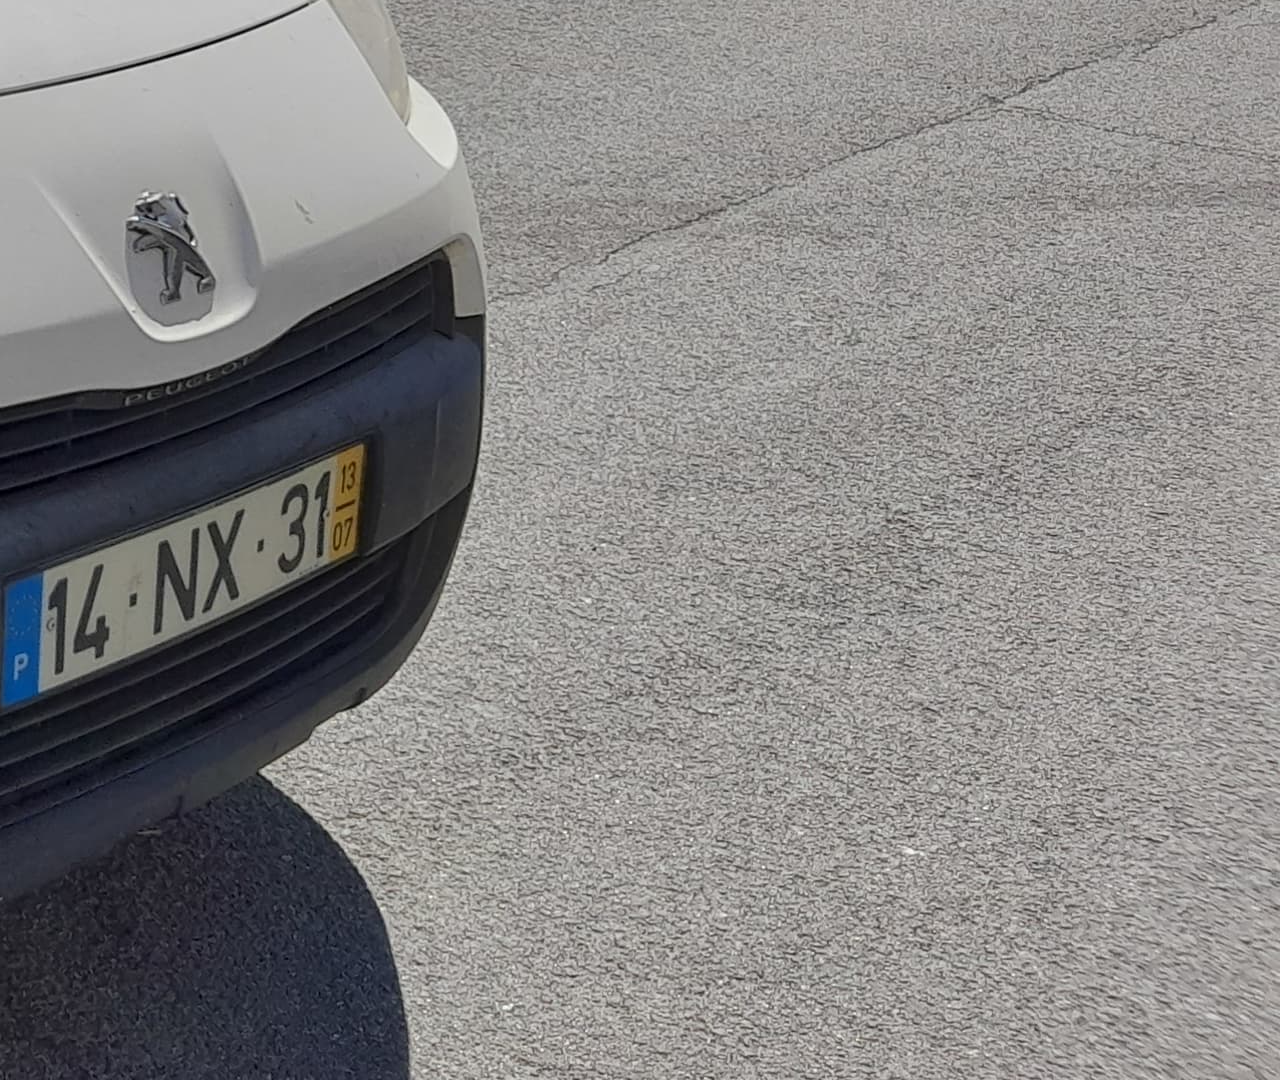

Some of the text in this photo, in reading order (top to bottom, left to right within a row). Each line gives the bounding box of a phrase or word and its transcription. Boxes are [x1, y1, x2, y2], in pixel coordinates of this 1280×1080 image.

[341, 460, 356, 493] 13
[331, 517, 353, 551] 07
[13, 653, 28, 681] P
